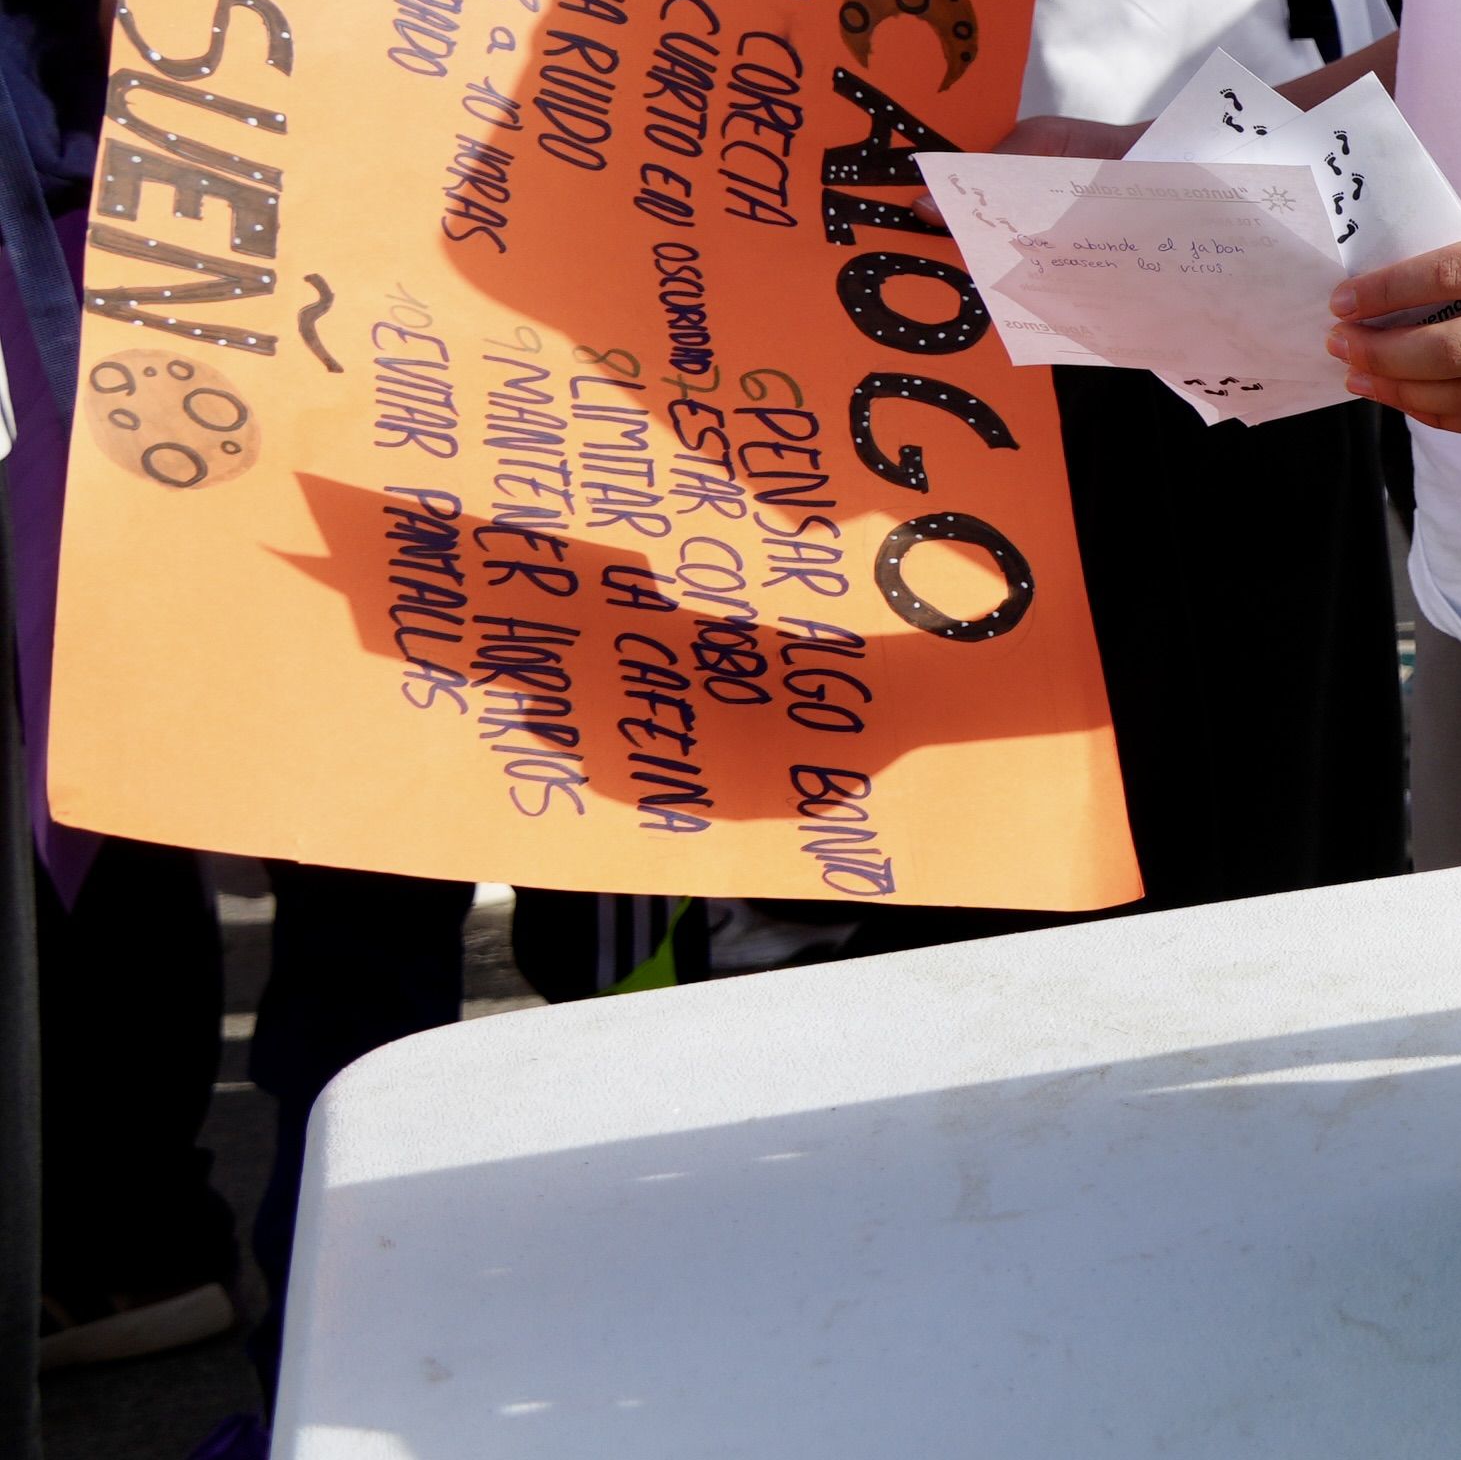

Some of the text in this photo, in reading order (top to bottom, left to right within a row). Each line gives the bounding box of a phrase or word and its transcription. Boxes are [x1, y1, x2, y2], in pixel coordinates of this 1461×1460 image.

[487, 26, 517, 55] a
[532, 30, 620, 171] RUIDO
[441, 133, 516, 255] HORAS
[633, 163, 696, 228] EN
[717, 31, 805, 228] CORECTA
[1017, 233, 1057, 250] Que
[1074, 237, 1140, 253] abunde
[1157, 237, 1177, 252] el
[1030, 257, 1045, 275] y
[1137, 257, 1162, 272] los
[371, 321, 460, 458] EVITAR
[568, 374, 672, 538] LIMITAR
[472, 354, 579, 597] MANTENER
[666, 398, 749, 521] ESTAR
[734, 407, 851, 597] PENSAR
[382, 485, 469, 717] PANTALLAS
[601, 565, 680, 612] LA
[469, 615, 589, 817] HORARIOS
[613, 632, 714, 834] CAFEINA
[775, 616, 872, 733] ALGO
